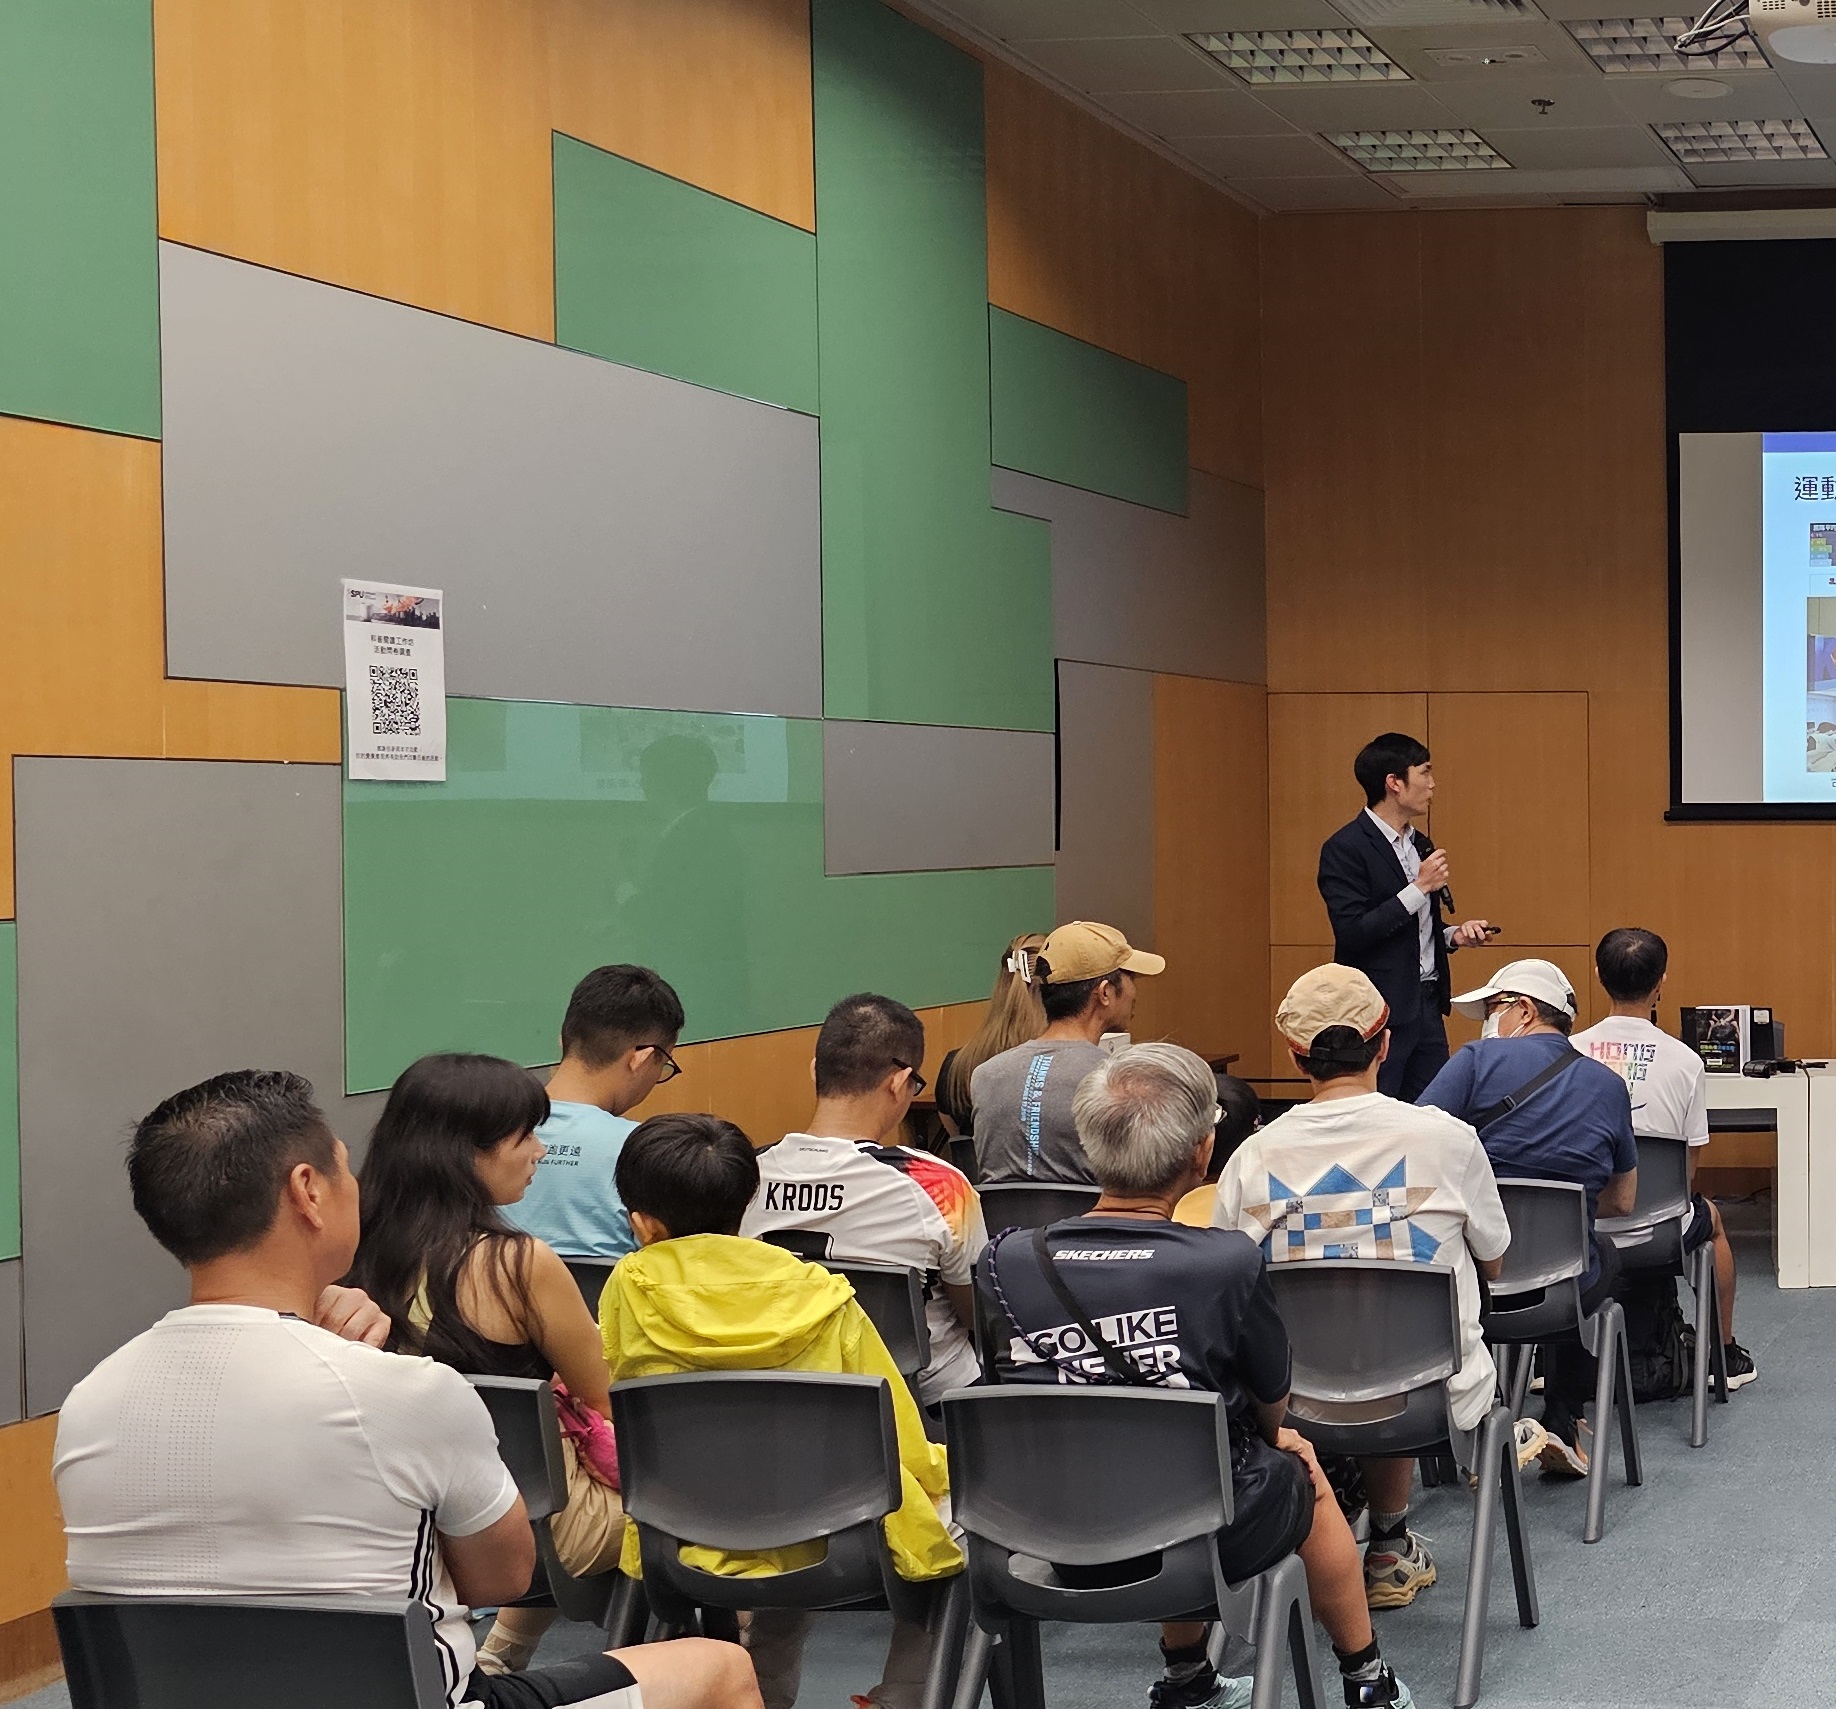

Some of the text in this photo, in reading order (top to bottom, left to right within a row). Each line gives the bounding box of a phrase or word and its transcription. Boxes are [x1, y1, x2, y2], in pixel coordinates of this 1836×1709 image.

[1035, 1055, 1055, 1088] THANKS
[1032, 1090, 1043, 1100] &
[765, 1181, 845, 1211] KROOS
[1053, 1249, 1156, 1261] SKECHERS
